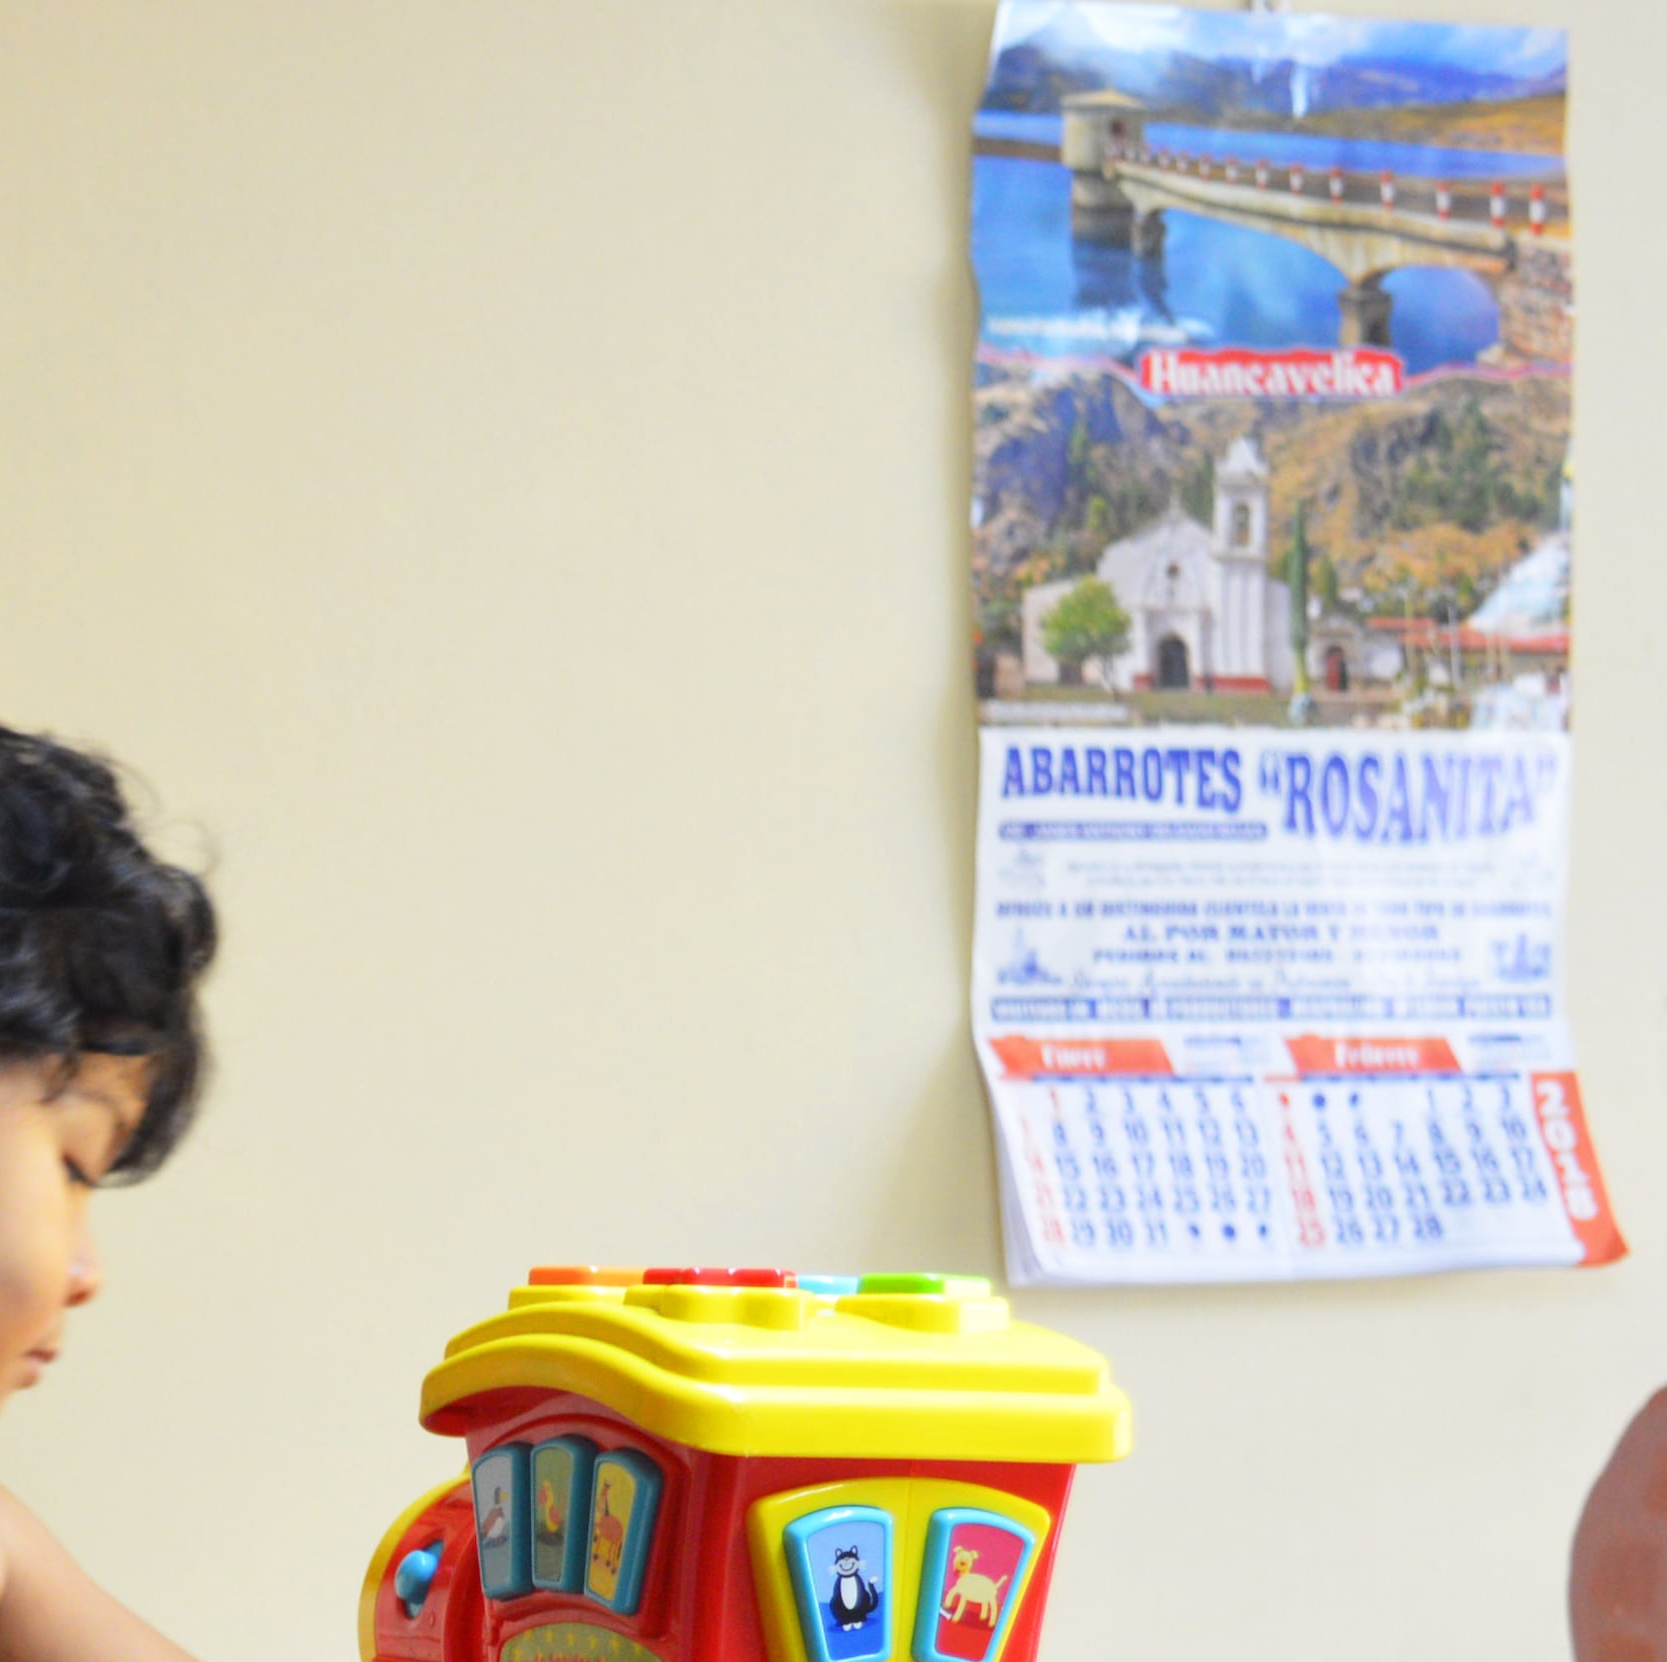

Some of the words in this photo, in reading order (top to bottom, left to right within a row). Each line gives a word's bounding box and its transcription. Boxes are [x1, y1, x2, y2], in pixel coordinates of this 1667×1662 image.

[1149, 351, 1395, 396] Huancavelica
[1002, 746, 1242, 814] ABARROTES
[1536, 1079, 1598, 1222] 2018
